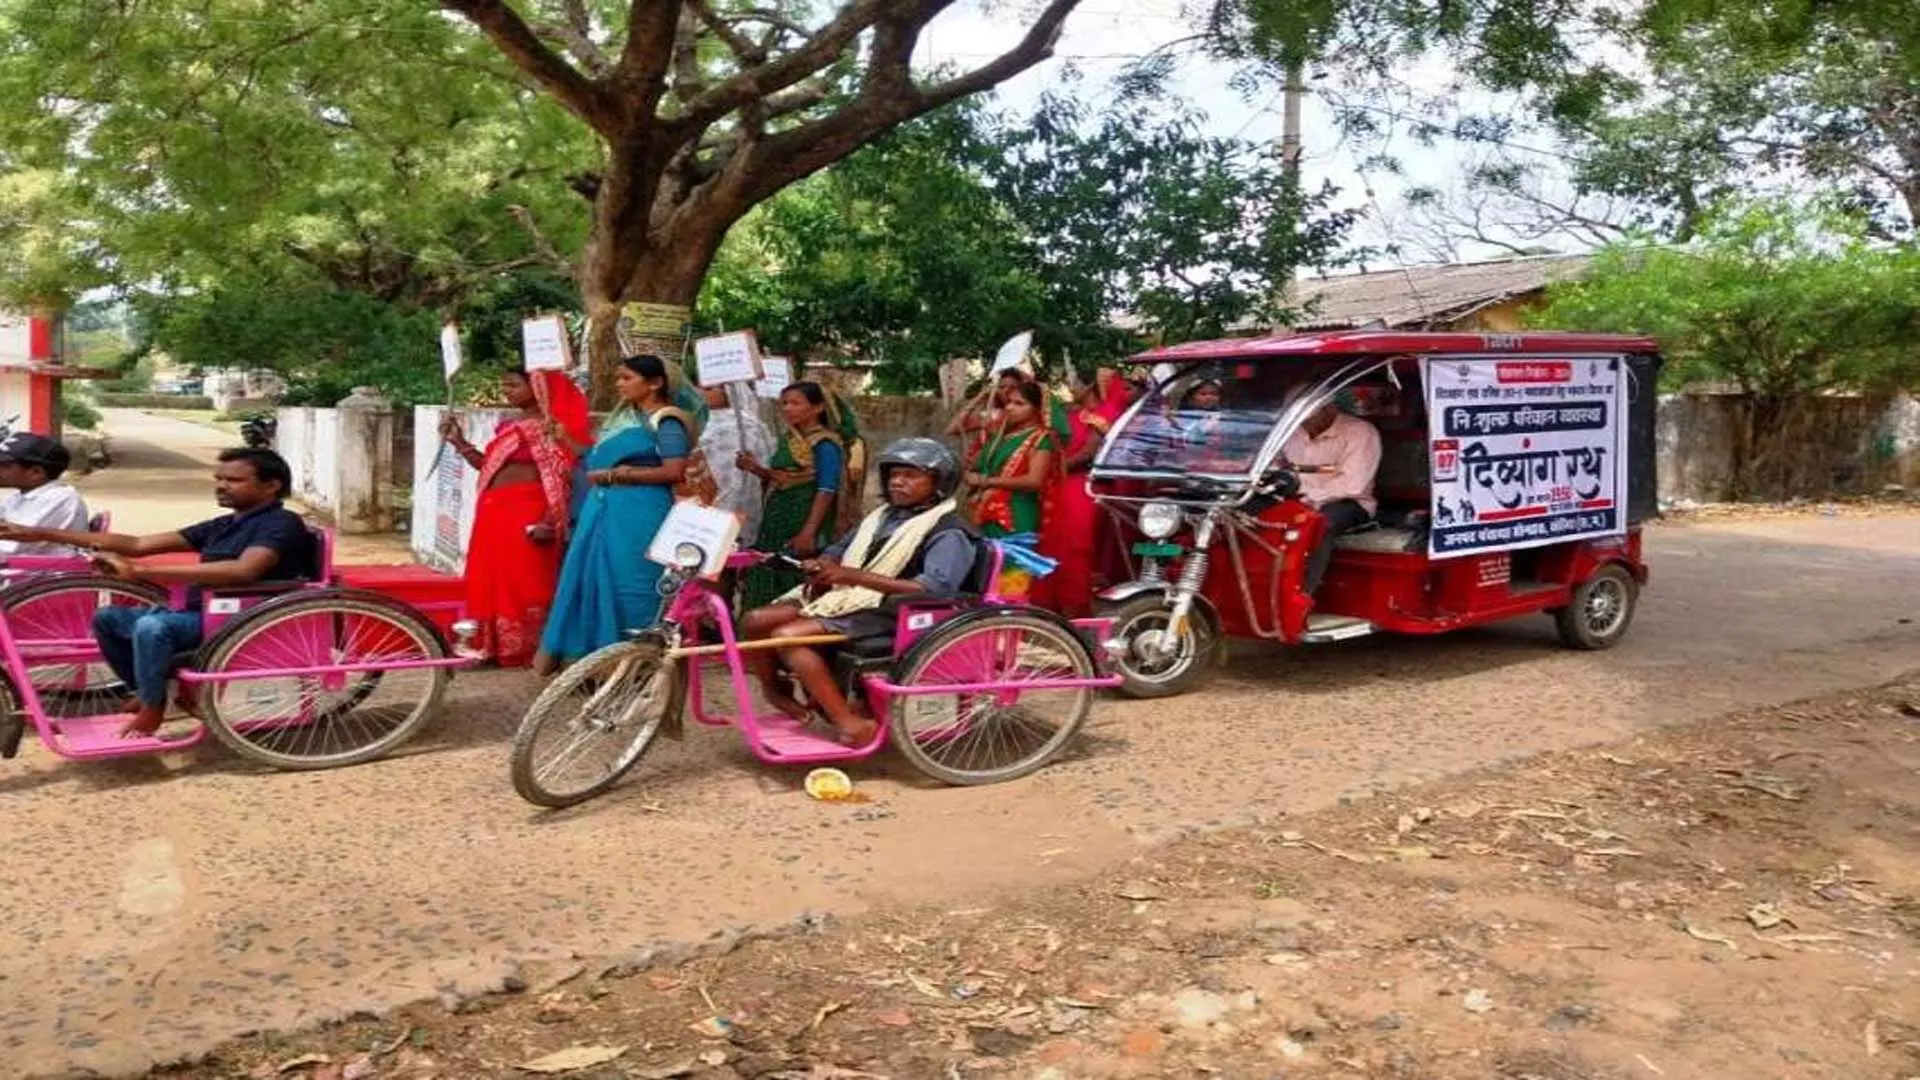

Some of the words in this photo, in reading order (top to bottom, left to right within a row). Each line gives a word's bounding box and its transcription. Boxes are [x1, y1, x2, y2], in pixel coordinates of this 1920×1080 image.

[1513, 406, 1556, 426] परिवहन
[1559, 407, 1601, 423] व्यवस्था
[1460, 438, 1561, 508] दिव्यांग
[1562, 446, 1606, 499] रथ
[1478, 526, 1512, 543] पंचायत
